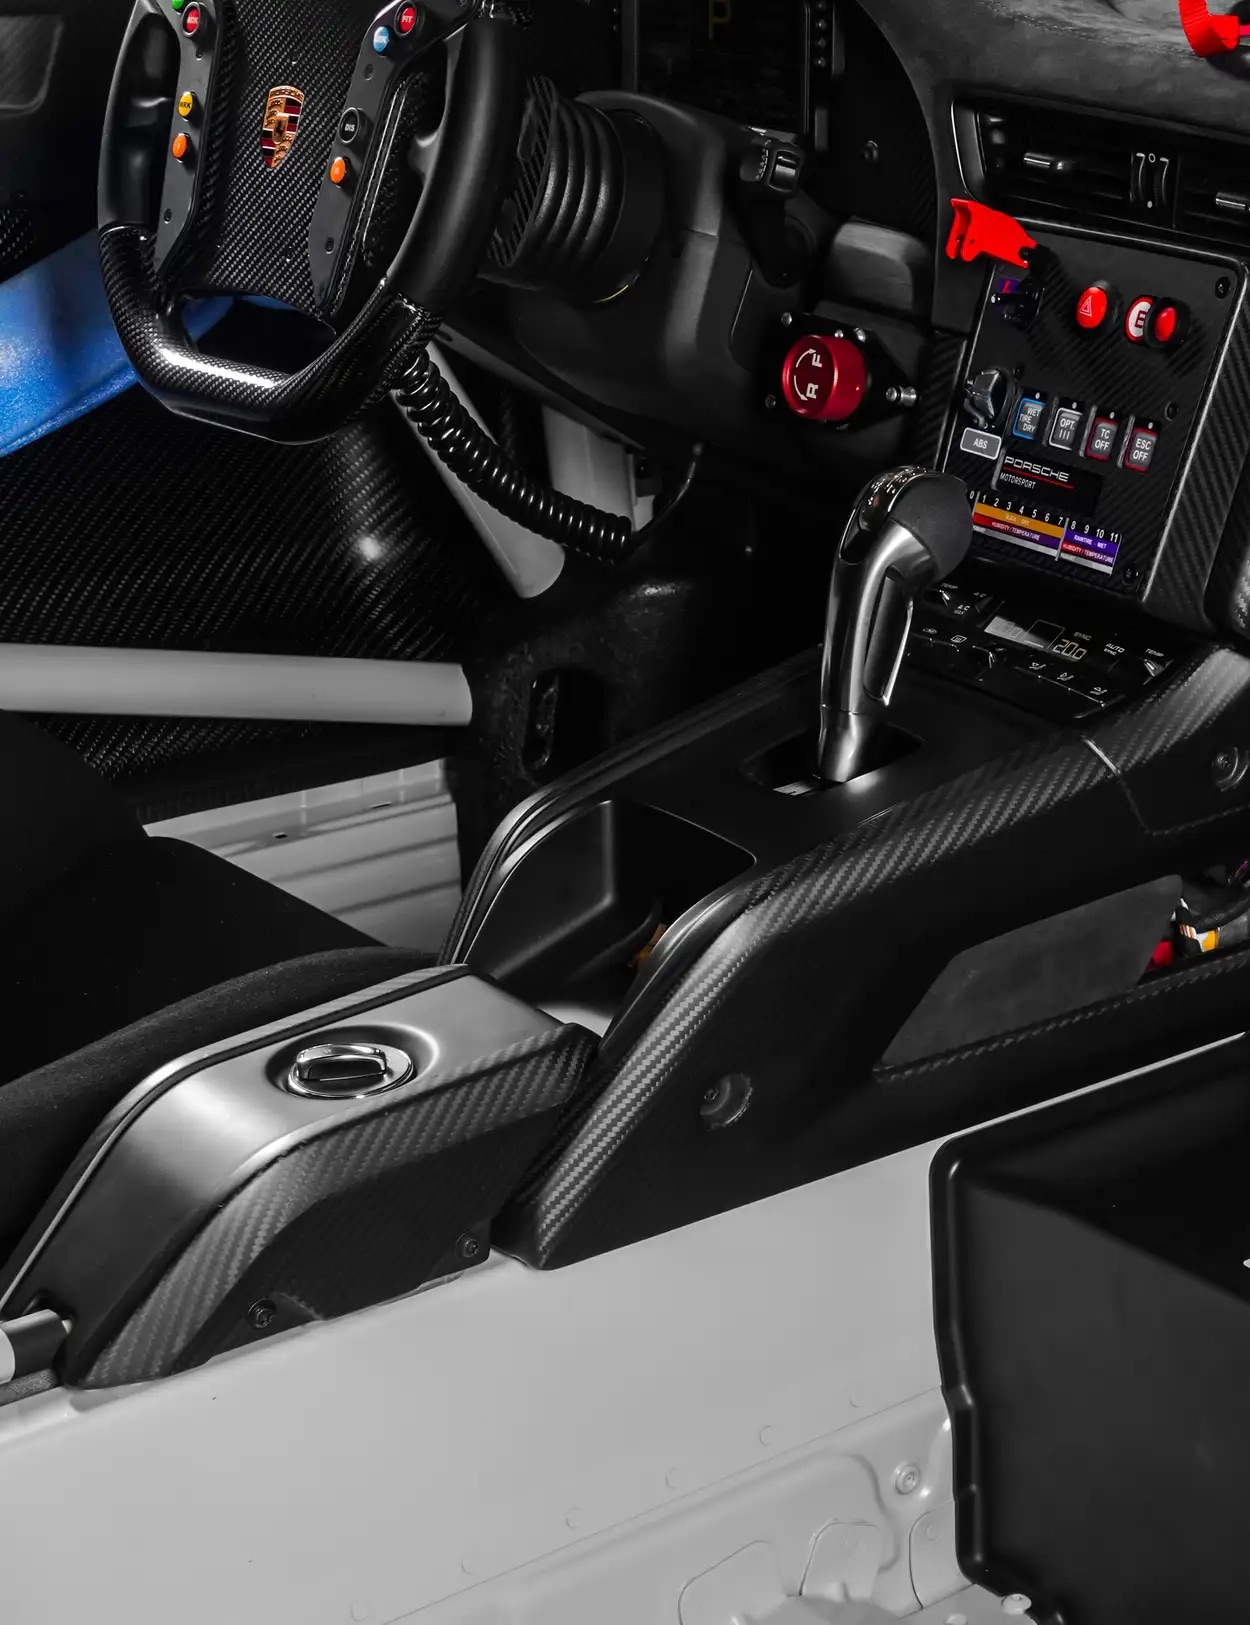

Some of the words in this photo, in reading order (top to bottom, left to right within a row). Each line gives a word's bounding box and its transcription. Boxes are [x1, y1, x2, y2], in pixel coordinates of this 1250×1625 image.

[344, 124, 355, 132] DIS
[812, 353, 822, 368] F
[806, 383, 818, 399] R
[1027, 407, 1041, 417] WET
[1019, 414, 1033, 424] TIRE
[1022, 424, 1036, 433] DRY
[1100, 428, 1111, 439] TC
[973, 438, 988, 449] ABS
[1094, 440, 1110, 450] OFF
[1136, 439, 1152, 450] ESC
[1133, 450, 1149, 461] OFF
[1004, 456, 1070, 482] PORSCHE
[1000, 472, 1037, 489] MOTORSPORT
[970, 490, 975, 499] 0
[982, 494, 986, 503] 1
[994, 498, 999, 507] 2
[1006, 502, 1012, 510] 3
[1019, 506, 1024, 514] 4
[1032, 509, 1038, 518] 5
[1044, 513, 1050, 522] 6
[1058, 517, 1063, 525] 7
[1070, 521, 1076, 530] 8
[1084, 524, 1090, 534] 9
[1096, 528, 1105, 538] 10
[1110, 532, 1118, 542] 11
[1105, 643, 1125, 653] AUTO
